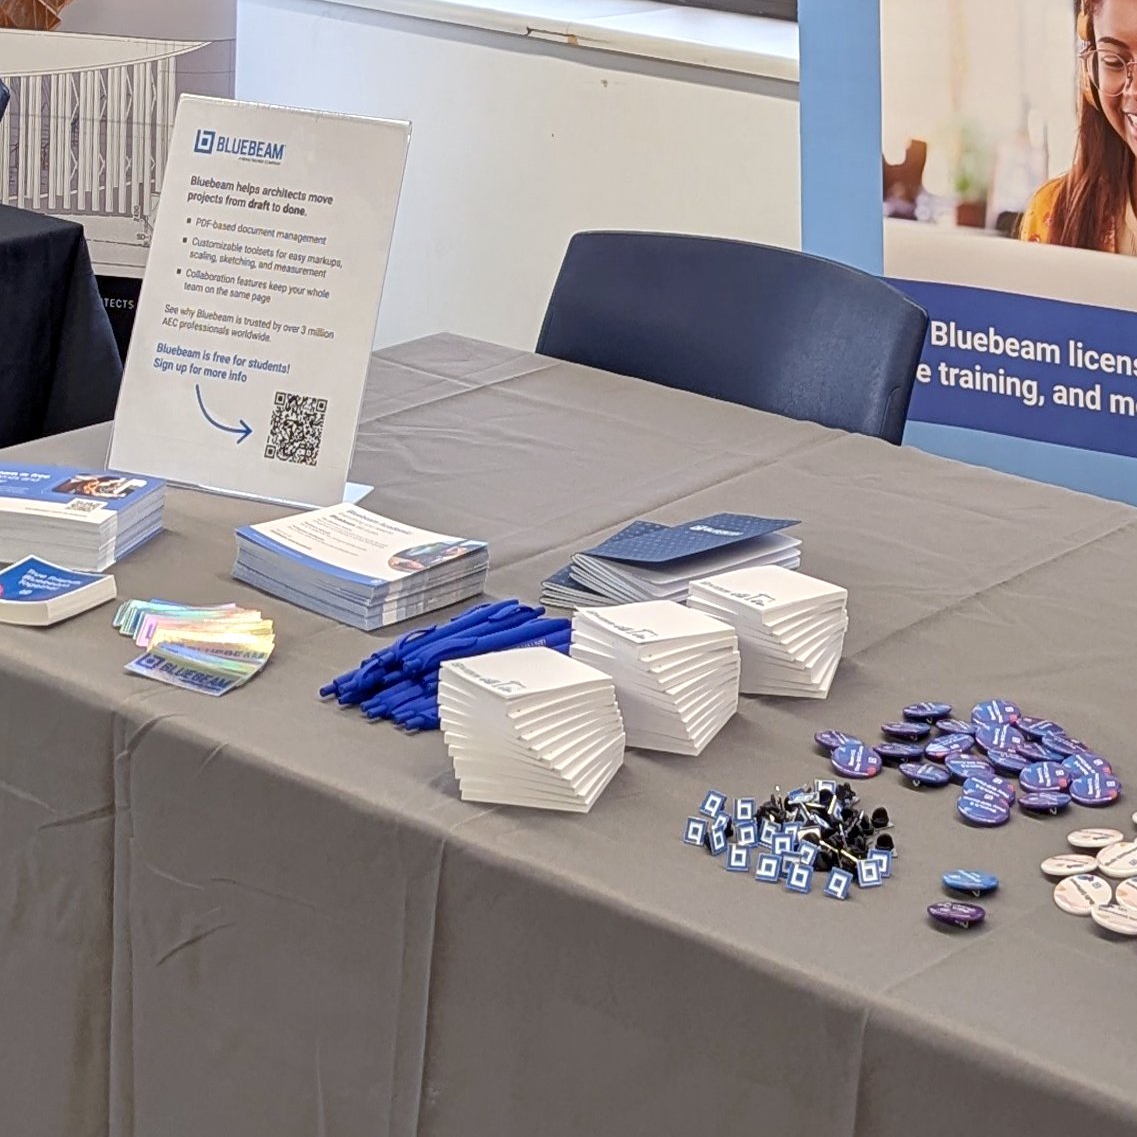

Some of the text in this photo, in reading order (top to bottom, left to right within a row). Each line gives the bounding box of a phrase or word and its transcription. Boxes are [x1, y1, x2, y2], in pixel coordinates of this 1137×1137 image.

[216, 136, 285, 160] BLUEBEAM
[187, 191, 307, 217] projects from draft to done.
[190, 175, 334, 205] Bluebeam helps architects move
[195, 217, 327, 246] PDF-based document management
[192, 237, 343, 270] Customizable toolsets for easy markups,
[258, 260, 273, 271] and
[274, 263, 327, 278] measurement
[184, 281, 272, 305] team on the same page
[185, 268, 330, 300] Collaboration features keep your whole
[162, 317, 179, 328] AEC
[179, 320, 229, 337] professionals
[164, 304, 179, 315] See
[180, 306, 195, 318] why
[196, 308, 235, 323] Bluebeam
[236, 315, 242, 325] is
[244, 316, 271, 330] trusted
[272, 320, 282, 332] by
[282, 324, 299, 334] over
[300, 325, 307, 335] 3
[930, 320, 1061, 365] Bluebeam
[152, 357, 248, 383] Sign up for more info
[156, 342, 290, 375] Bluebeam is free for students!
[938, 361, 1045, 408] training,
[1052, 384, 1102, 411] and
